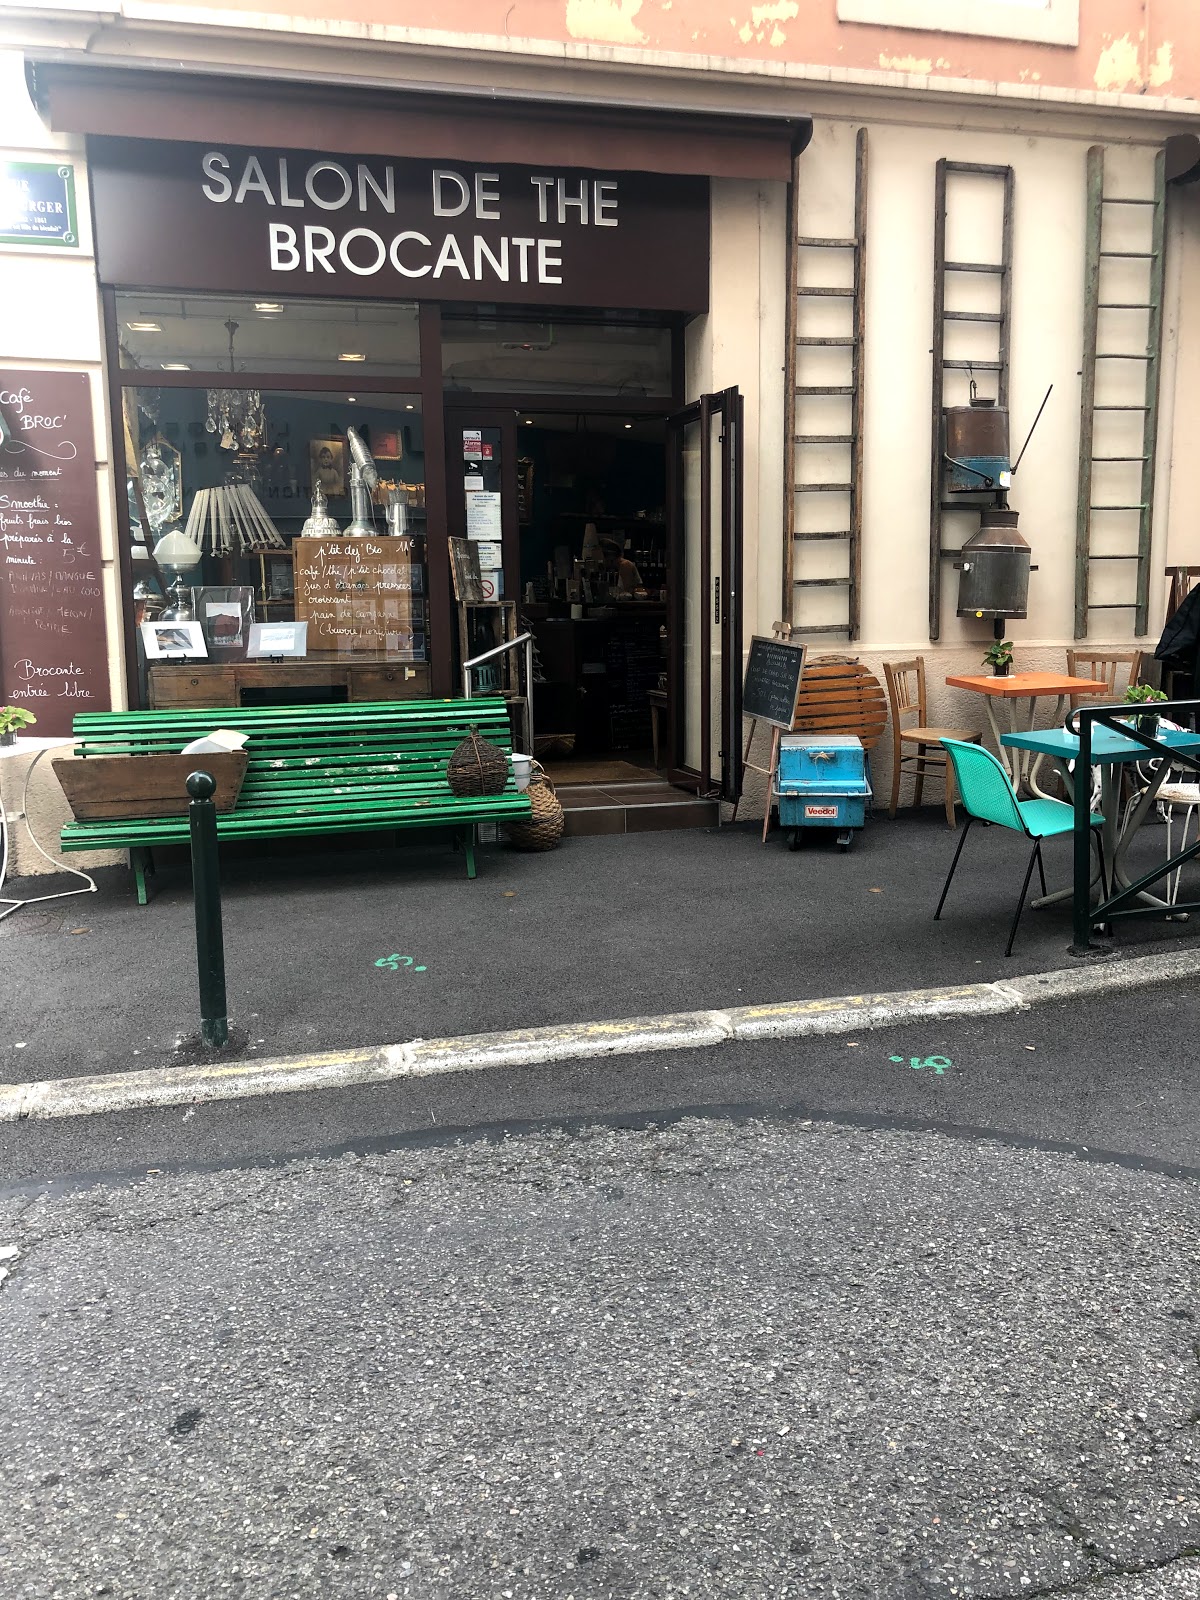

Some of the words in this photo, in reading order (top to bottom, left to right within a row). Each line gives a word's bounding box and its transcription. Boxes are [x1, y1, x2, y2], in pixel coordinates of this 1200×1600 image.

[201, 151, 396, 214] SALON
[432, 169, 501, 220] DE
[530, 176, 619, 227] THE
[268, 223, 563, 285] BROCANTE
[0, 387, 34, 414] Café
[20, 414, 67, 430] BROC'
[0, 494, 50, 510] Smoothie
[0, 512, 24, 531] fruits
[26, 513, 49, 529] frais
[60, 532, 74, 545] la
[308, 593, 352, 605] croissant
[14, 659, 84, 681] Brocante
[8, 682, 51, 699] entrée
[57, 681, 96, 699] libre
[807, 807, 836, 815] Veedol
